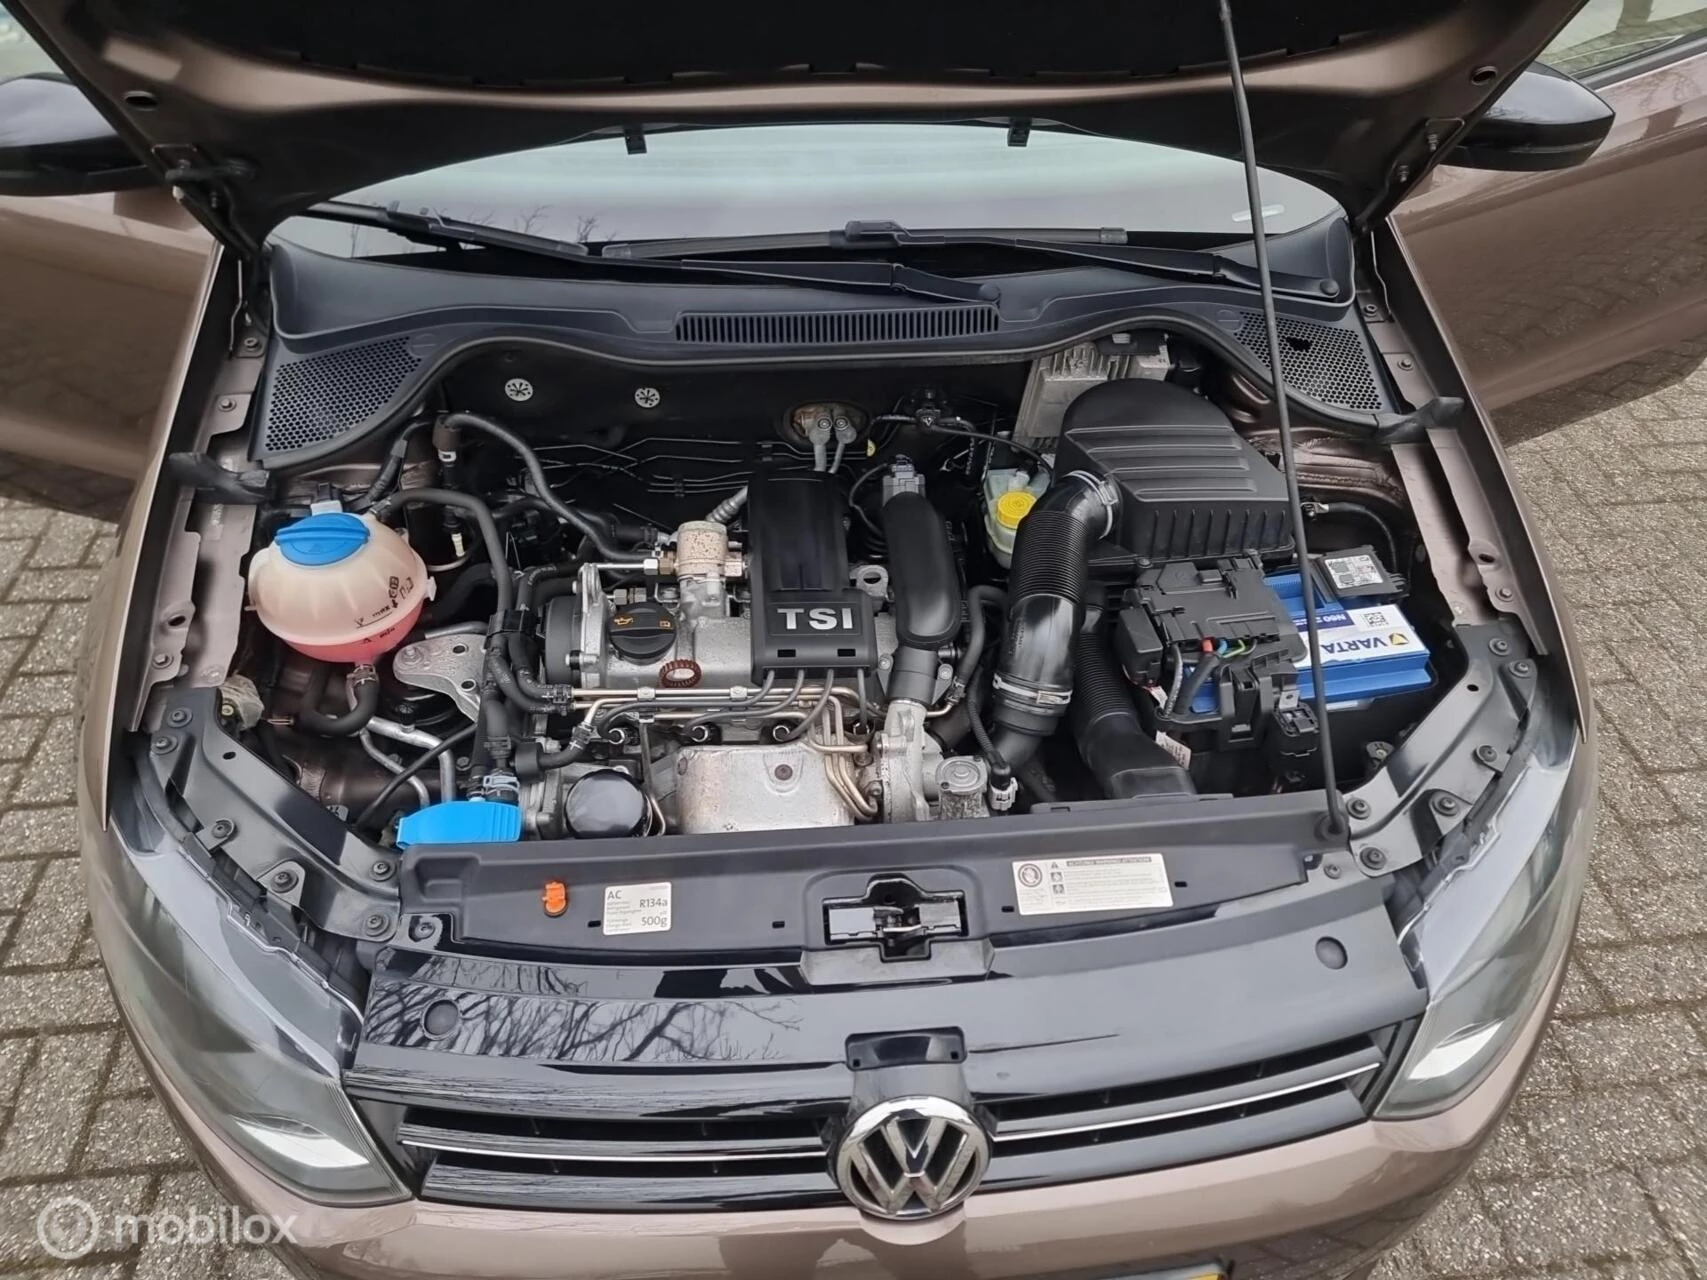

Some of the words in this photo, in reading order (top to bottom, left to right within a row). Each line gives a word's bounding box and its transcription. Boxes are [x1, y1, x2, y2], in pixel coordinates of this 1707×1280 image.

[777, 608, 853, 630] TSI
[1320, 636, 1388, 655] VARTA
[607, 889, 622, 900] AC
[639, 897, 668, 908] R134a
[641, 915, 668, 928] 500g
